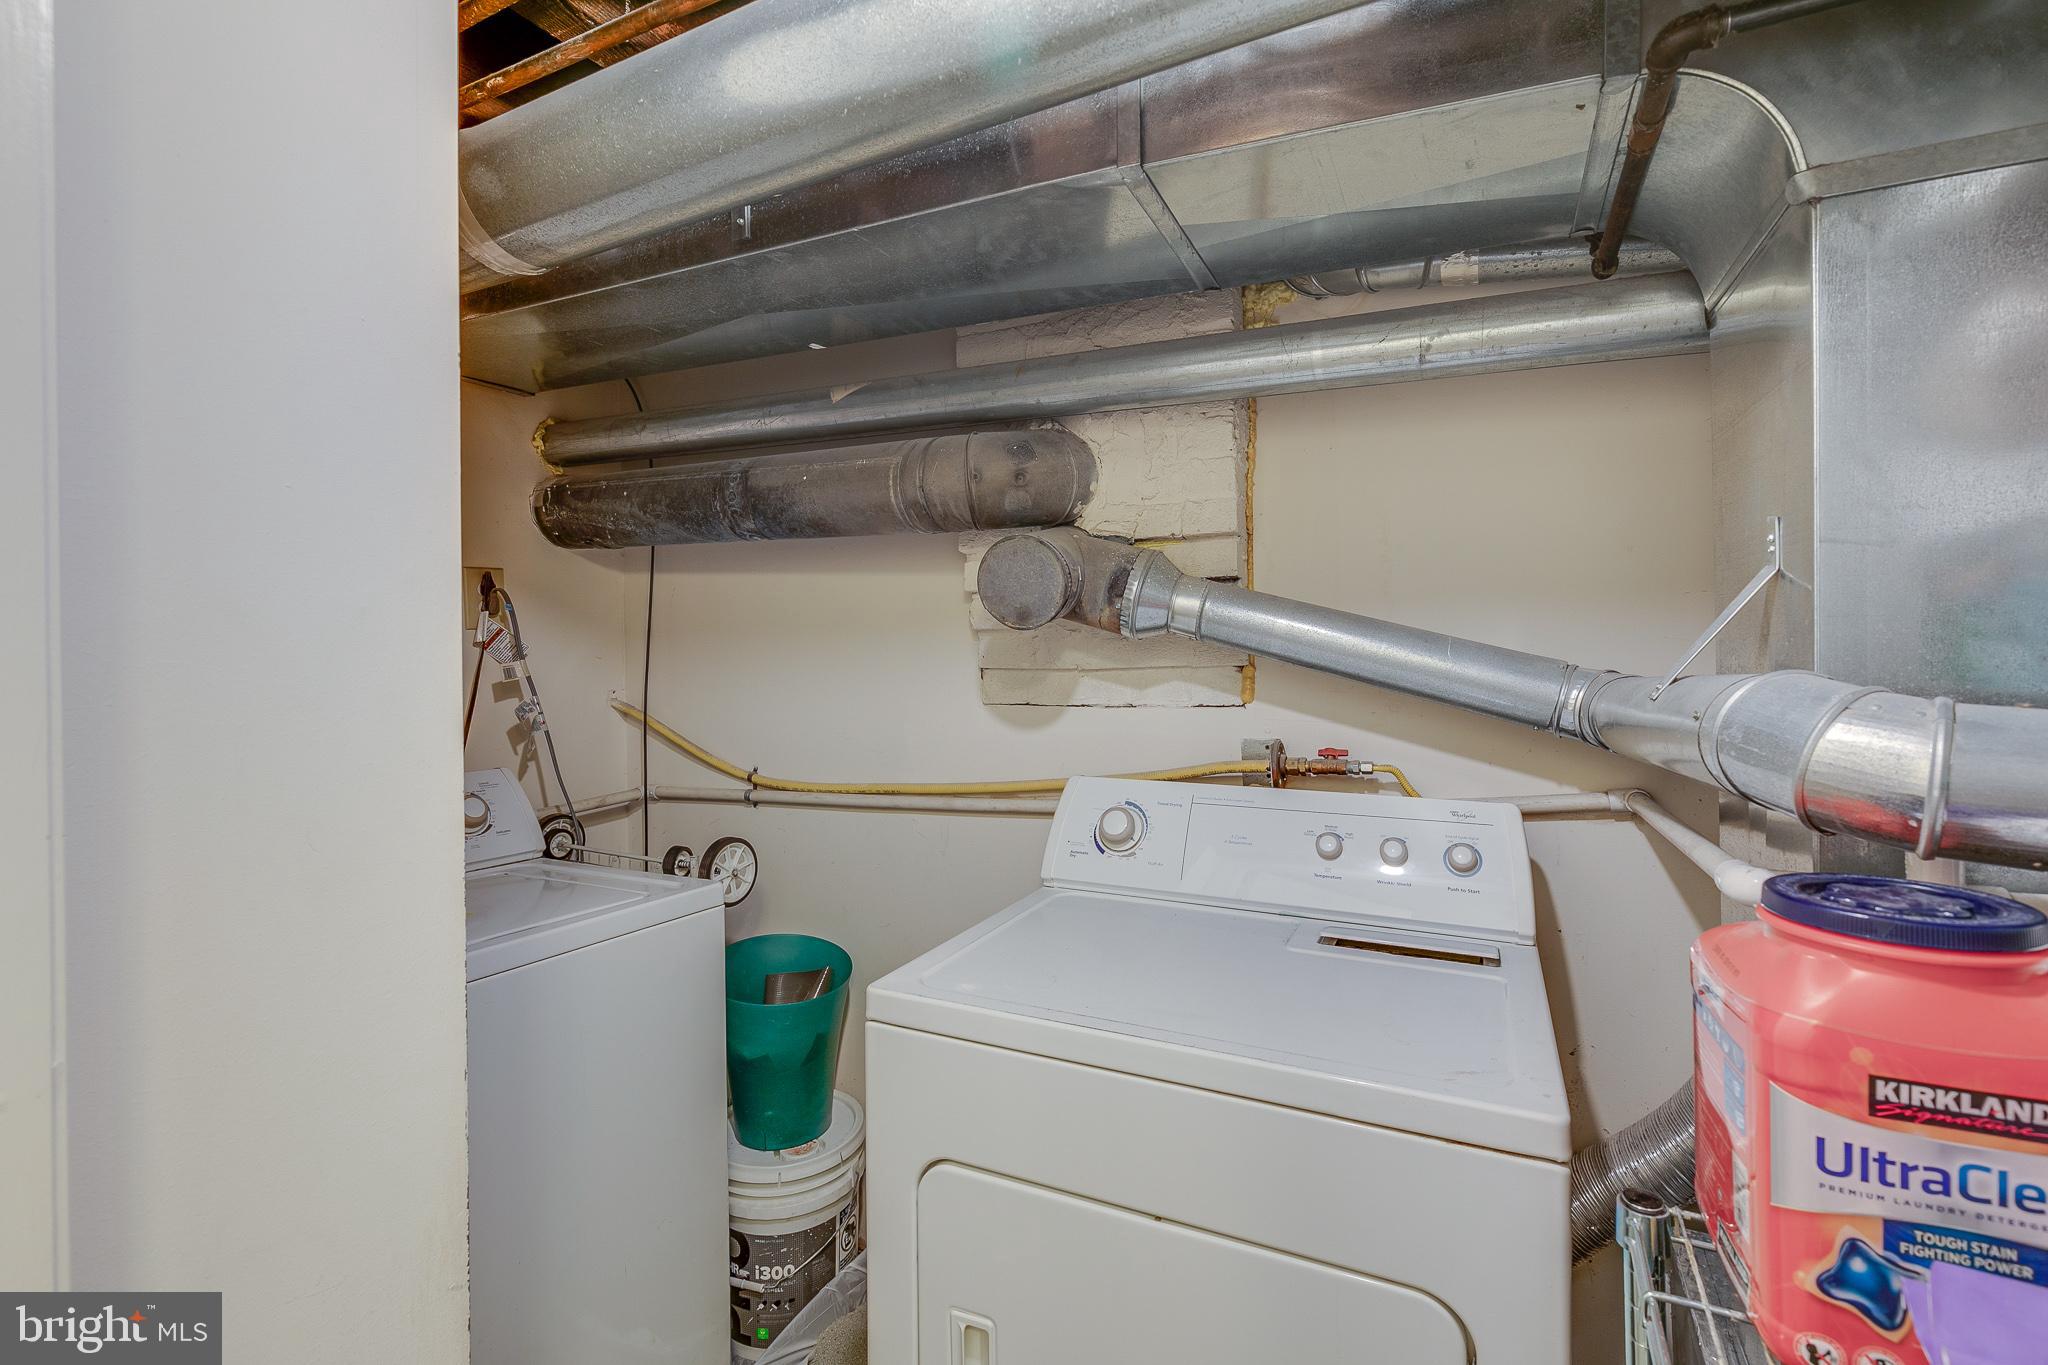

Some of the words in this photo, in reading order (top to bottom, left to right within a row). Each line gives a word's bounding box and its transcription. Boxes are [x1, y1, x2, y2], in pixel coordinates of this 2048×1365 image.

[1313, 872, 1343, 880] Temperature
[1874, 1079, 2048, 1127] KIRKLAND
[1874, 1103, 2048, 1138] Signature
[1815, 1136, 2047, 1216] UltraCle
[1818, 1181, 1886, 1202] PREMIUM
[1893, 1197, 1967, 1218] LAUNDRY
[1899, 1241, 1971, 1268] FIGHTING
[1973, 1256, 2035, 1281] POWER
[1912, 1228, 1968, 1252] TOUGH
[1970, 1240, 2018, 1262] STAIN
[754, 1263, 796, 1281] i300
